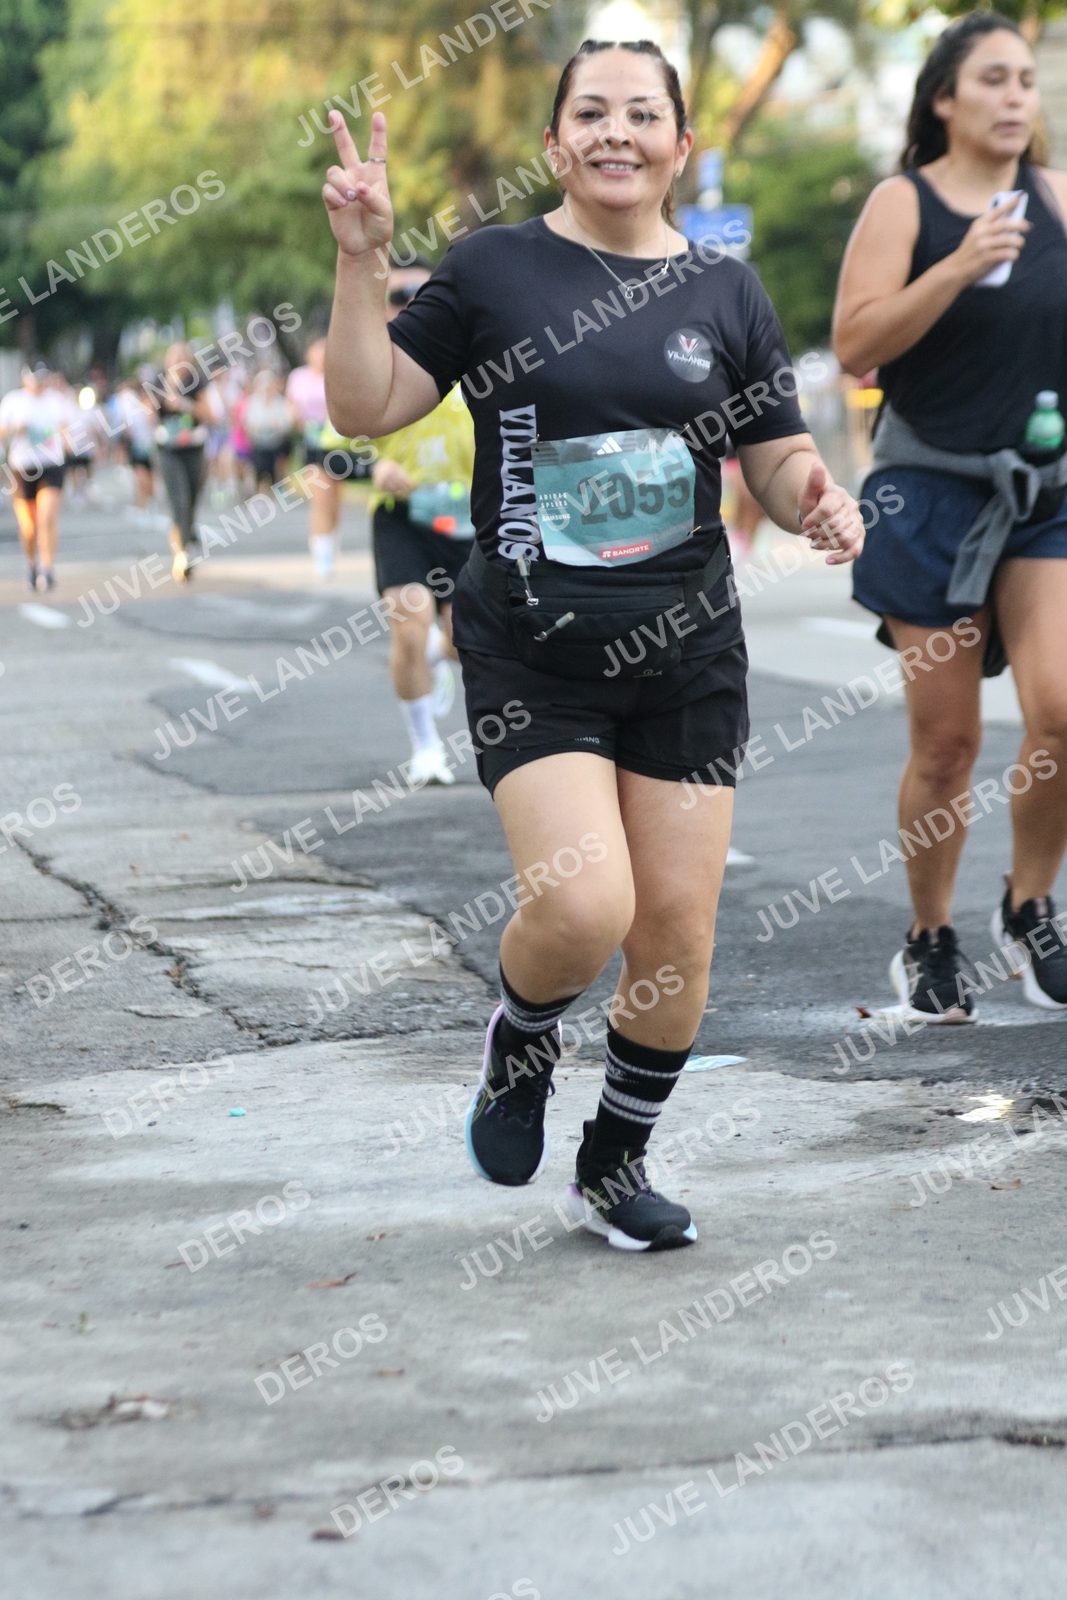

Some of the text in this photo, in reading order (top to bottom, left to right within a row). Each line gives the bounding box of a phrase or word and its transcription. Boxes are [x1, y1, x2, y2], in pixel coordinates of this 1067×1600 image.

[667, 349, 711, 370] VILLANOS
[498, 404, 541, 562] VILLANOS
[577, 462, 690, 526] 2055
[612, 544, 649, 557] BANORTE
